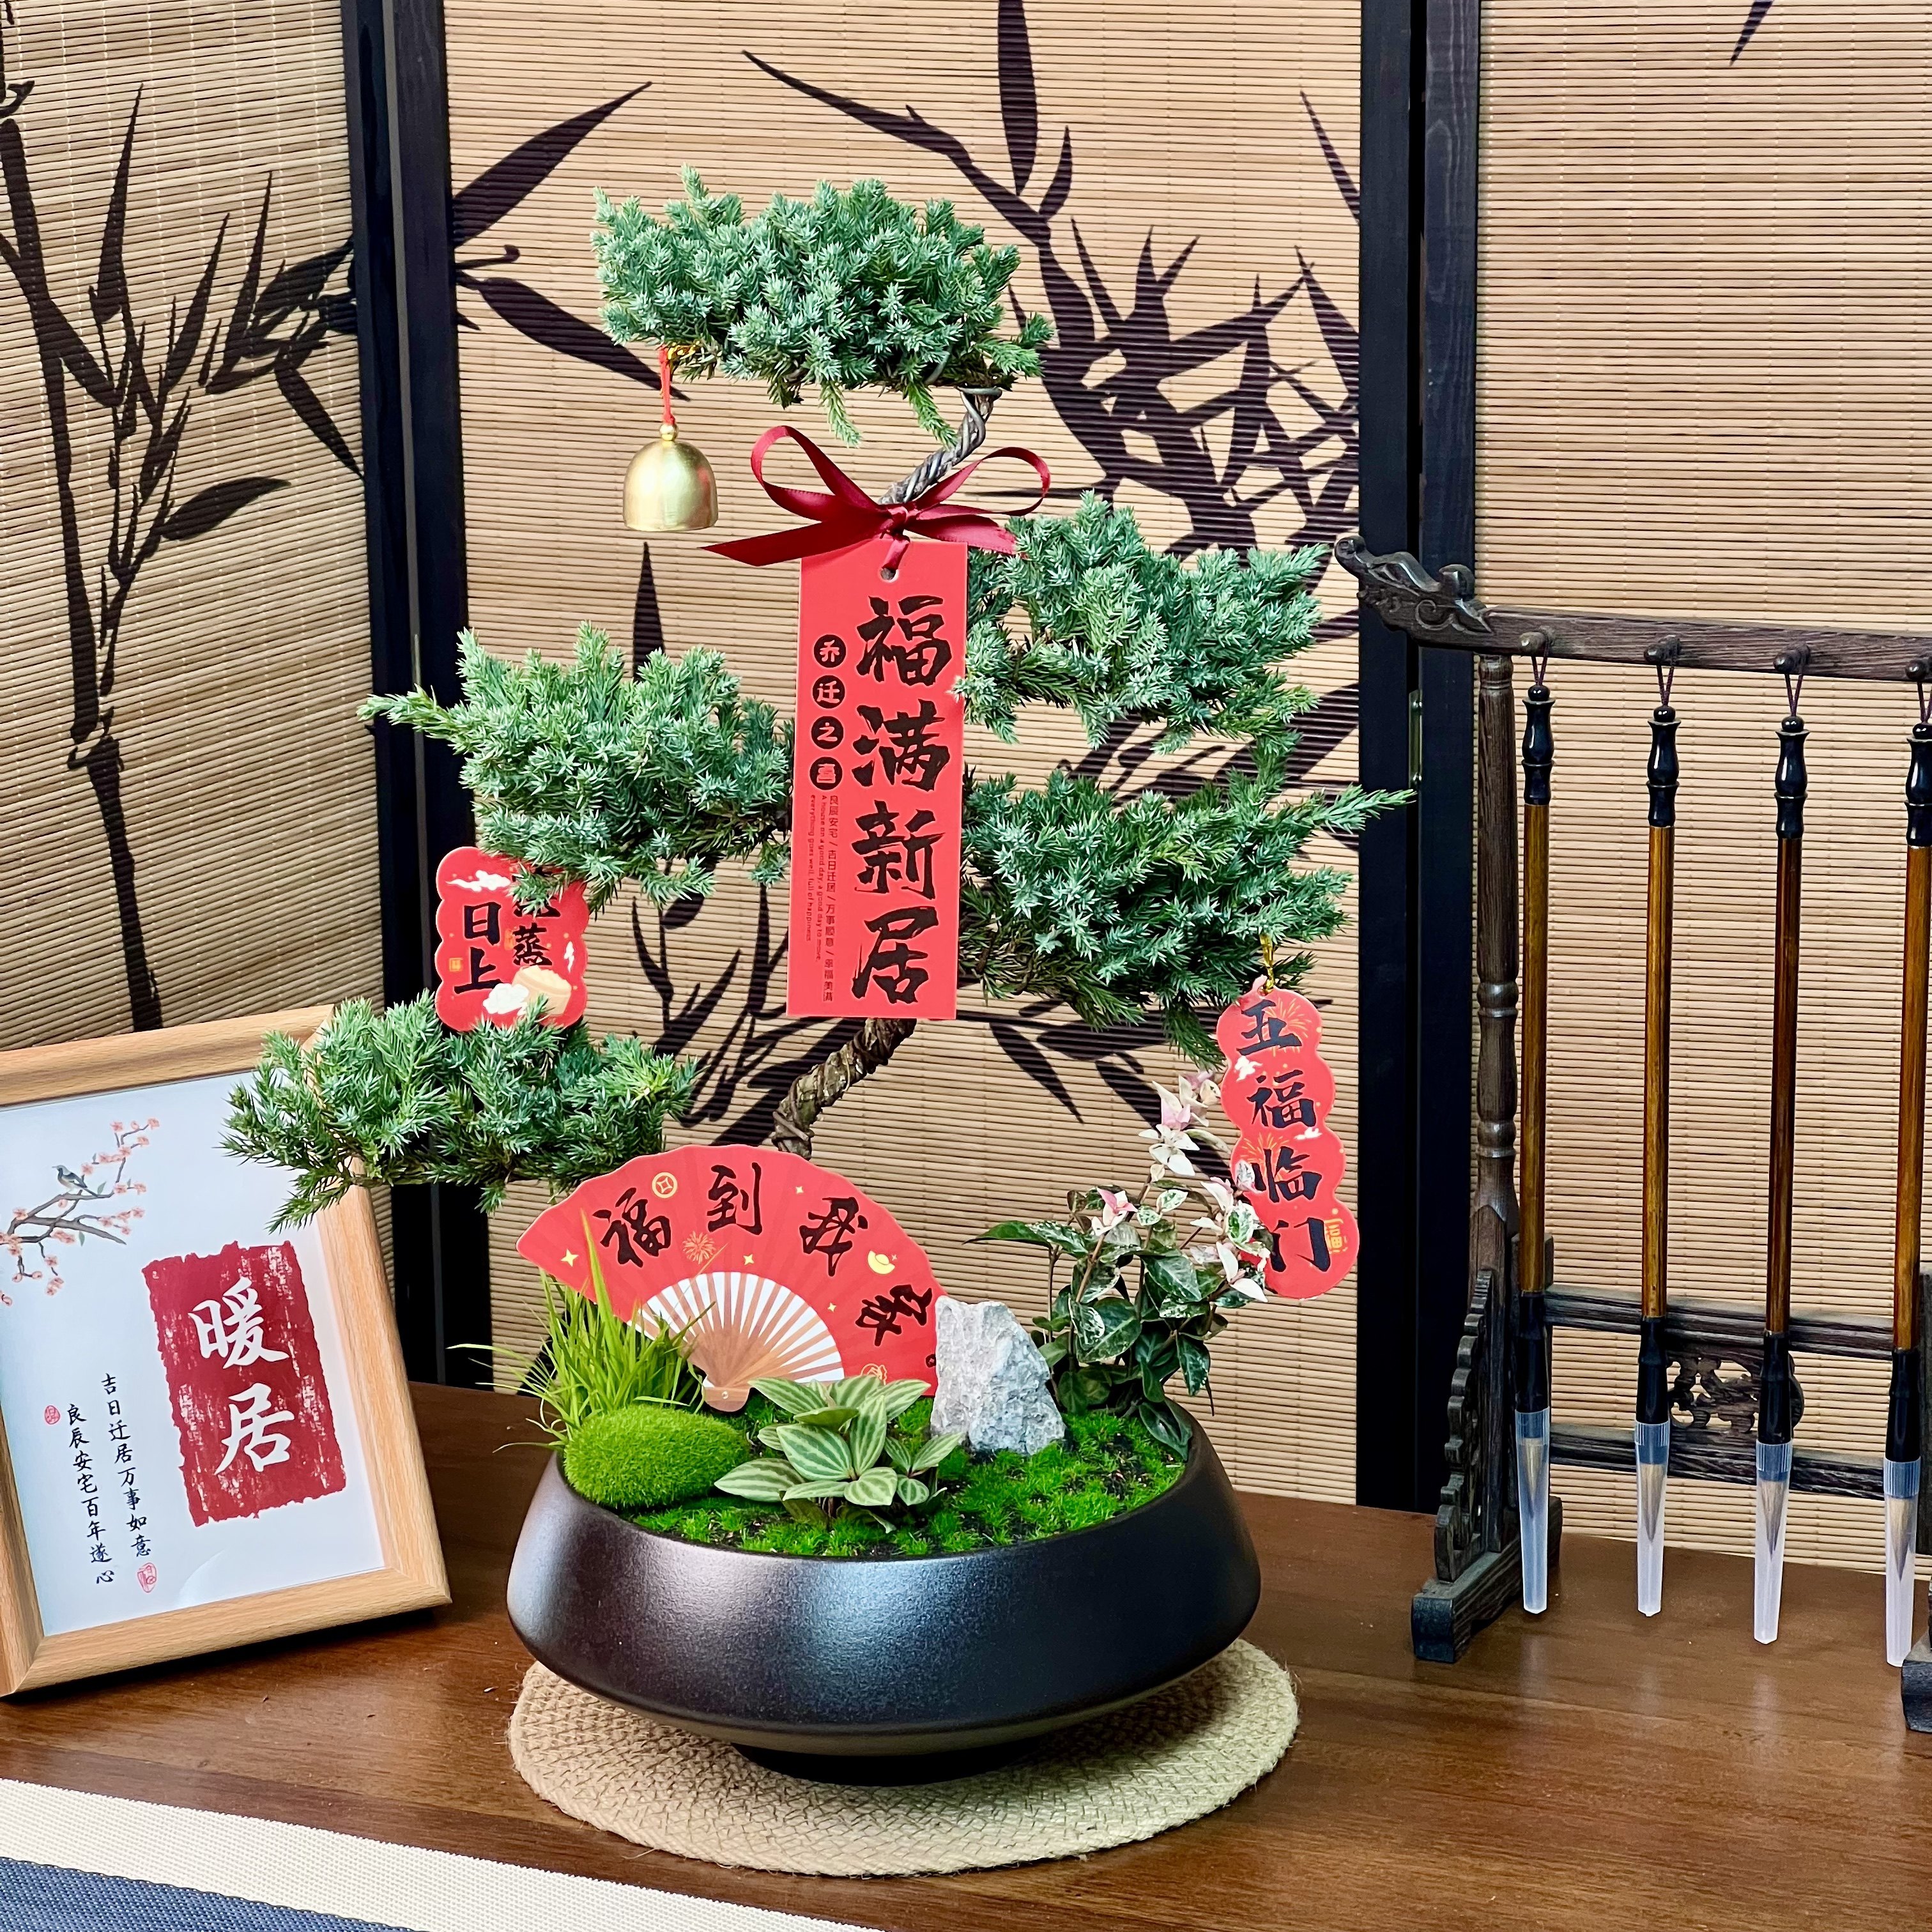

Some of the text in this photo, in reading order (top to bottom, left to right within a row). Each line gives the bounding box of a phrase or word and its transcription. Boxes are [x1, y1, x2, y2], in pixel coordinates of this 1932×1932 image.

[815, 638, 841, 785] 乔迁之喜
[851, 595, 953, 1006] 福满新居
[454, 901, 505, 995] 日上
[807, 892, 814, 900] of
[816, 929, 822, 937] to
[1236, 999, 1331, 1273] 五福临门
[592, 1162, 933, 1346] 福到我家
[101, 1372, 153, 1558] 吉日迁居万事如意
[188, 1276, 295, 1477] 暖居
[66, 1402, 116, 1584] 良辰安宅百年遂心
